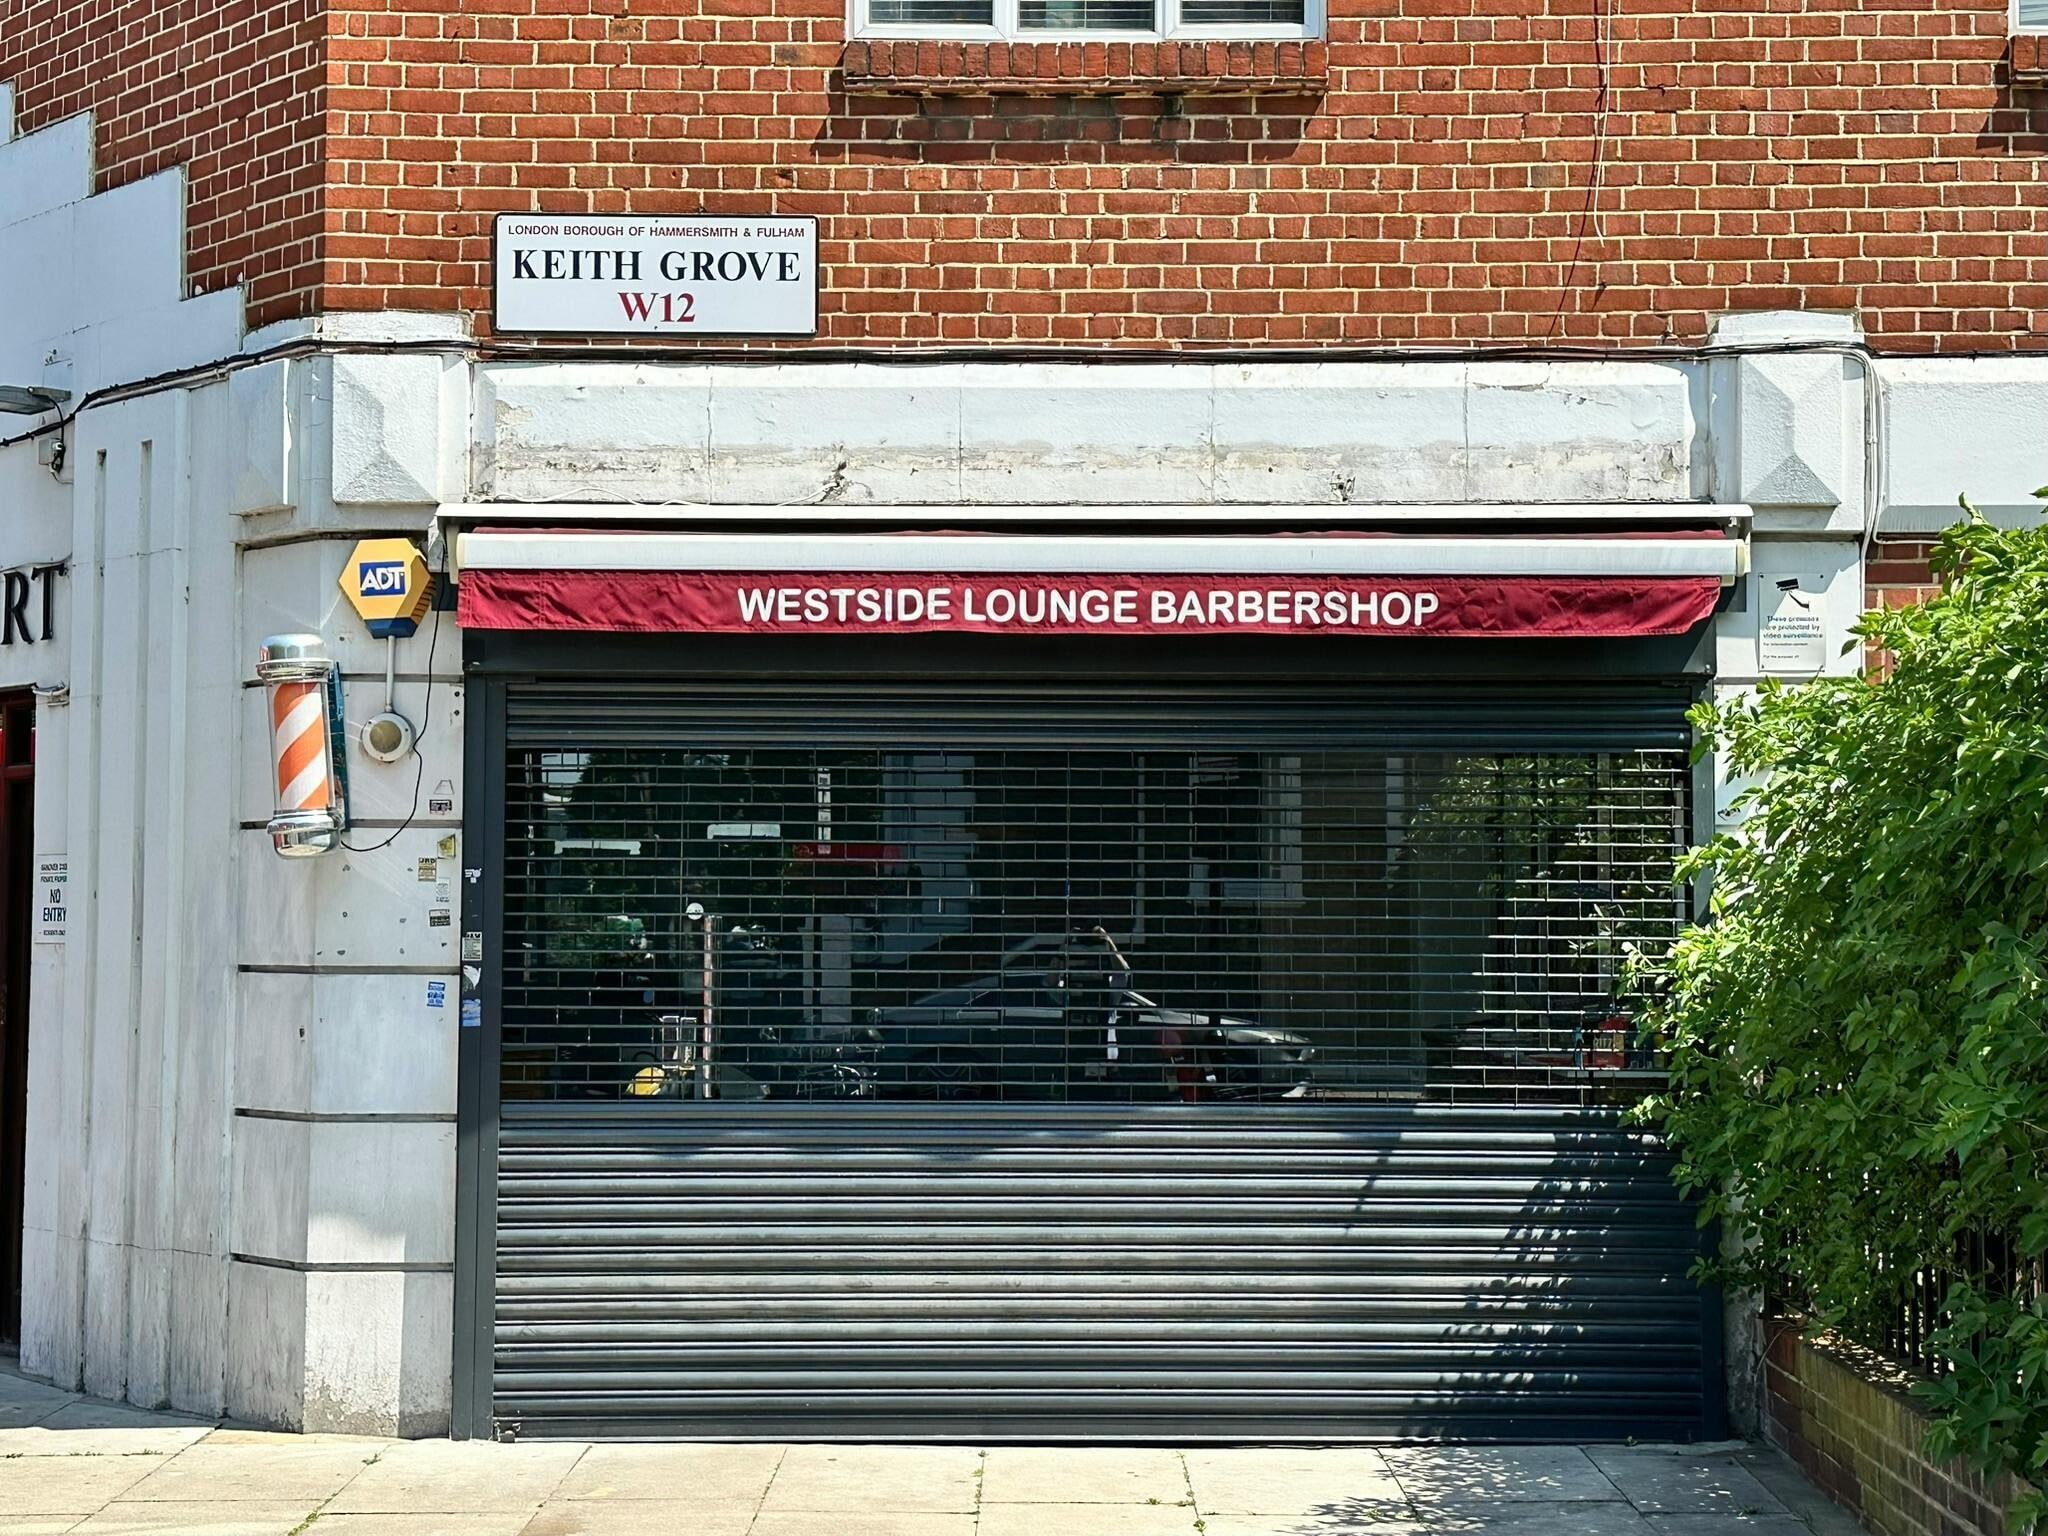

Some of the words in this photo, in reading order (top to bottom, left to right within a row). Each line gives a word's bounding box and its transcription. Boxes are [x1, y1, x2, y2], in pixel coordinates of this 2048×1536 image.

[508, 224, 559, 236] LONDON
[563, 225, 624, 237] BOROUGH
[628, 226, 645, 237] OF
[650, 226, 738, 238] HAMMERSMITH
[743, 227, 752, 238] &
[757, 227, 805, 238] FULHAM
[512, 248, 643, 281] KEITH
[659, 250, 801, 282] GROVE
[617, 291, 696, 323] W12
[360, 566, 405, 591] ADT
[736, 586, 952, 623] WESTSIDE
[963, 587, 1138, 625] LOUNGE
[1149, 588, 1440, 627] BARBERSHOP
[50, 888, 61, 904] NO
[43, 907, 66, 922] ENTRY
